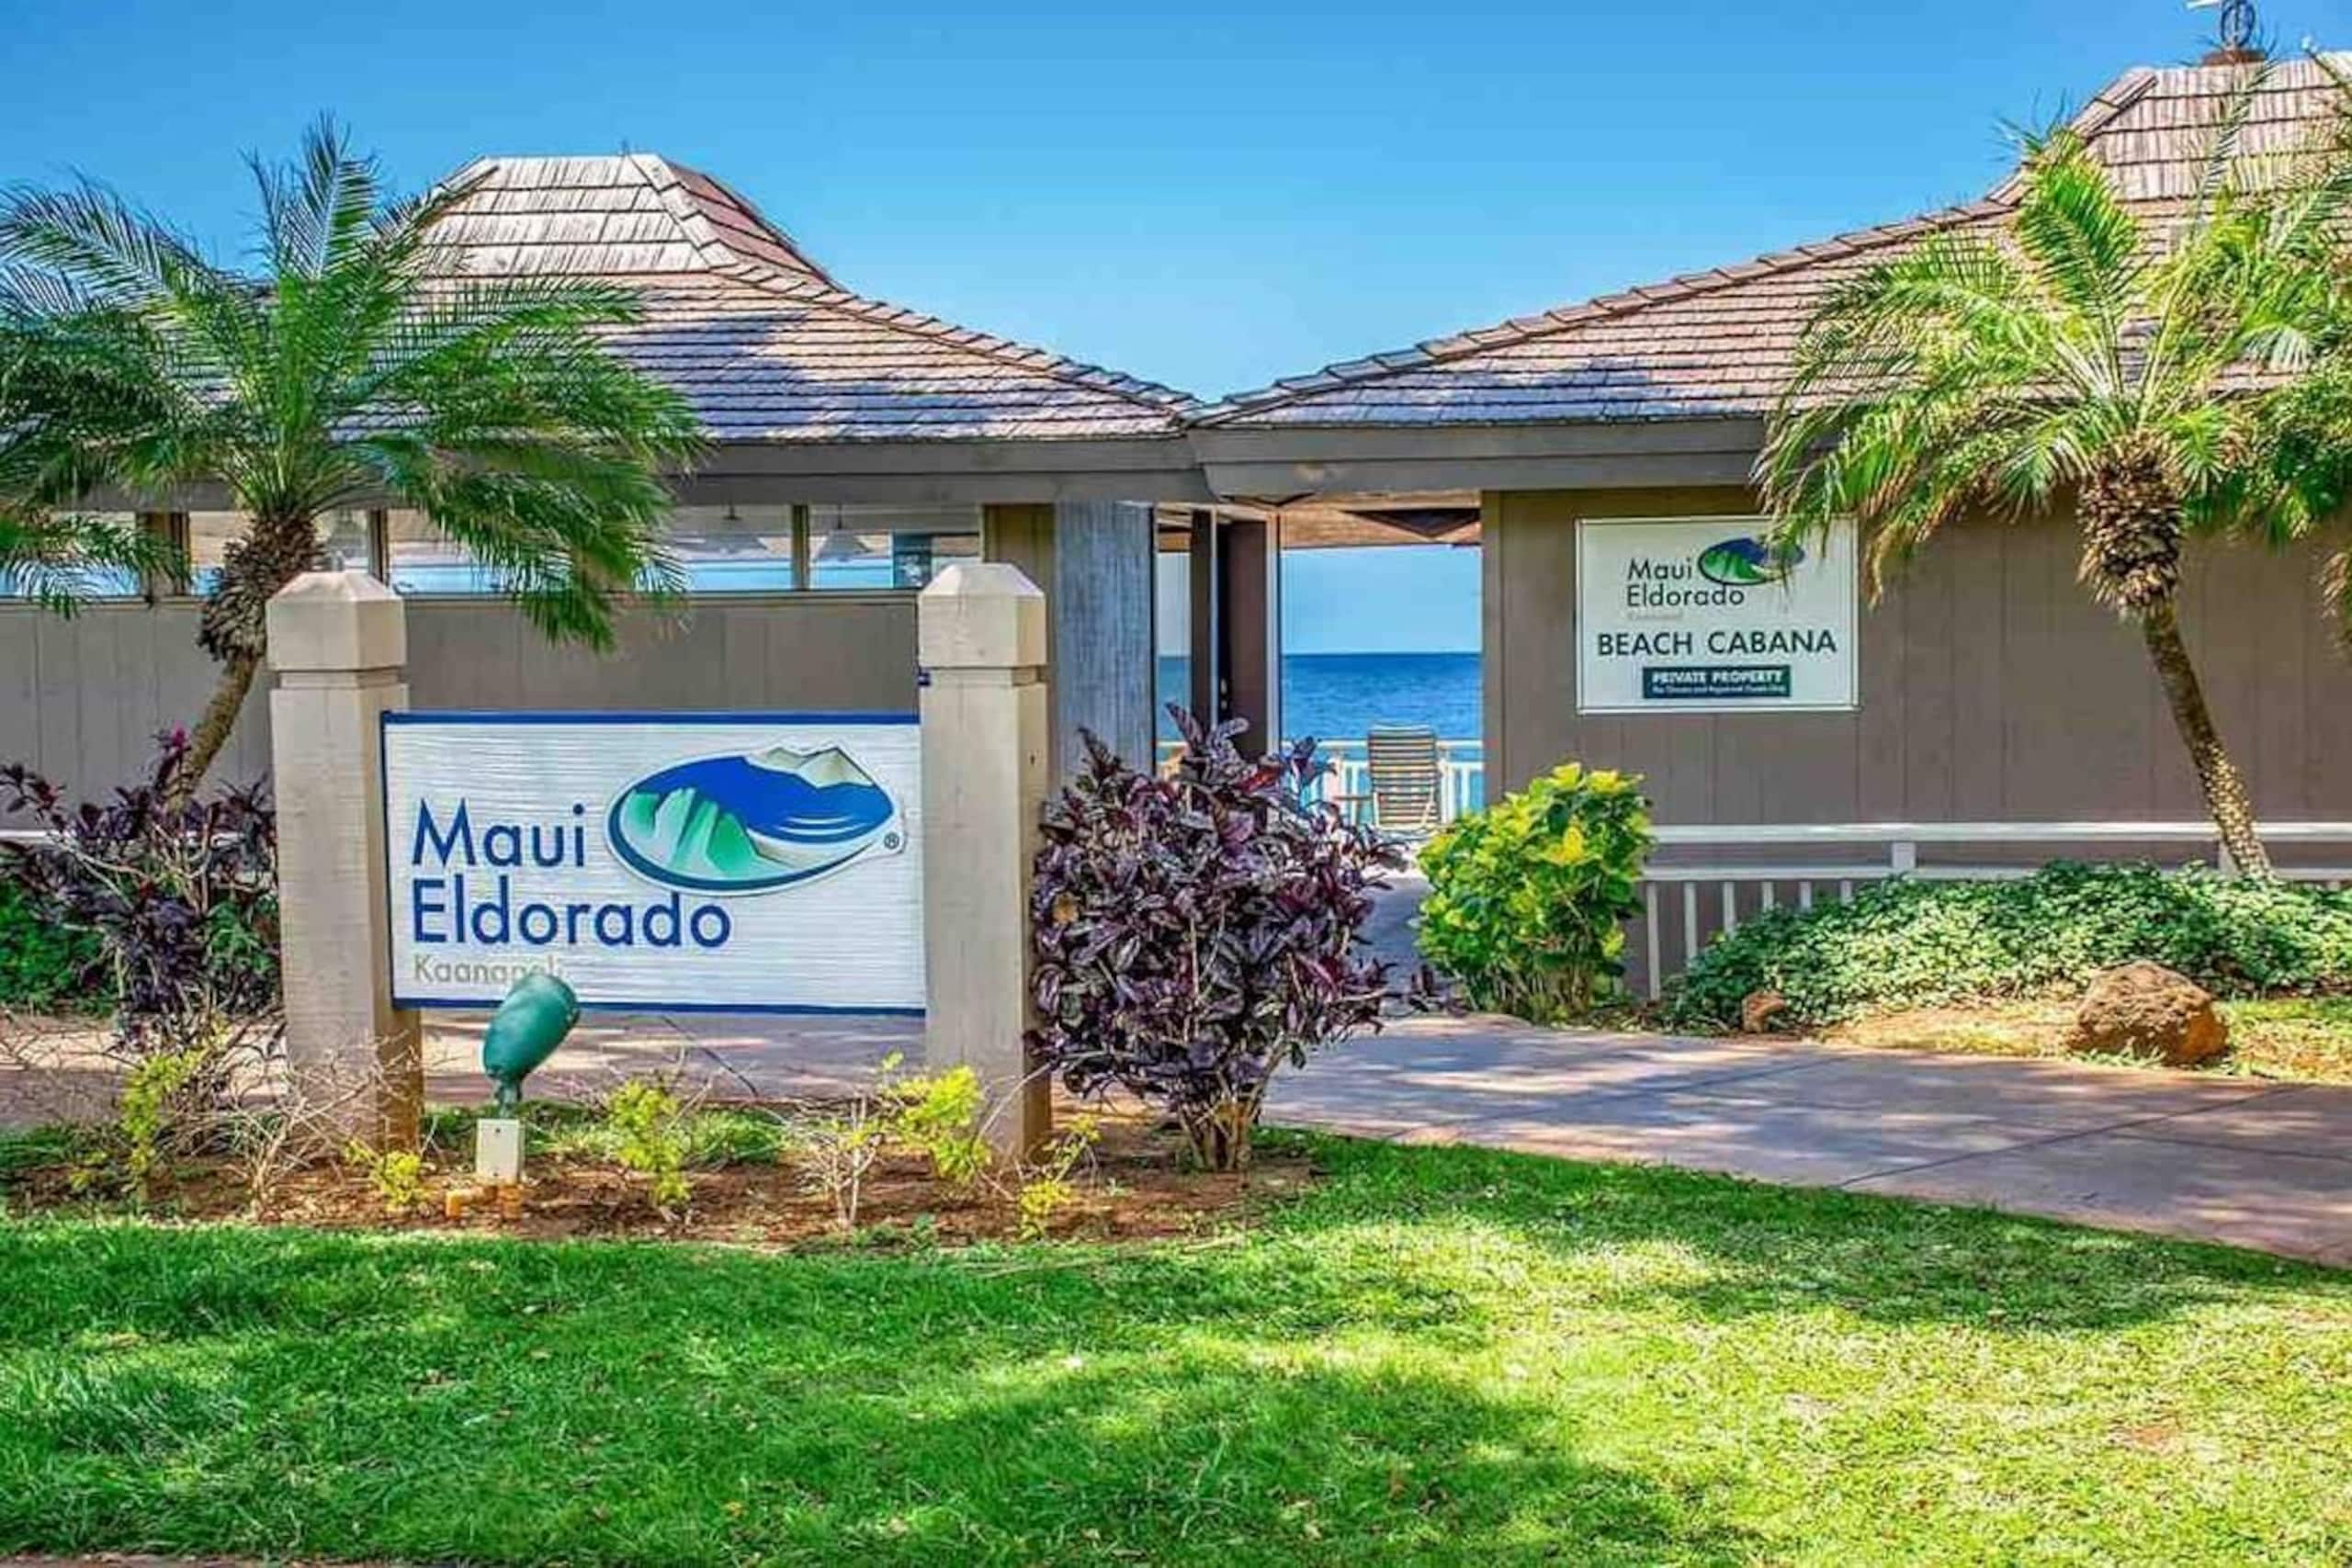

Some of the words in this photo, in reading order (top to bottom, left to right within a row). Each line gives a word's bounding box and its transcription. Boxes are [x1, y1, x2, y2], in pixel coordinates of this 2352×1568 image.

[1627, 558, 1691, 581] Maui
[1627, 583, 1745, 607] Eldorado
[1598, 632, 1692, 656] BEACH
[1707, 629, 1837, 654] CABANA
[1652, 671, 1706, 683] PRIVATE
[1713, 670, 1783, 683] PROPERTY
[411, 797, 586, 867] Maui
[412, 874, 732, 947] Eldorado
